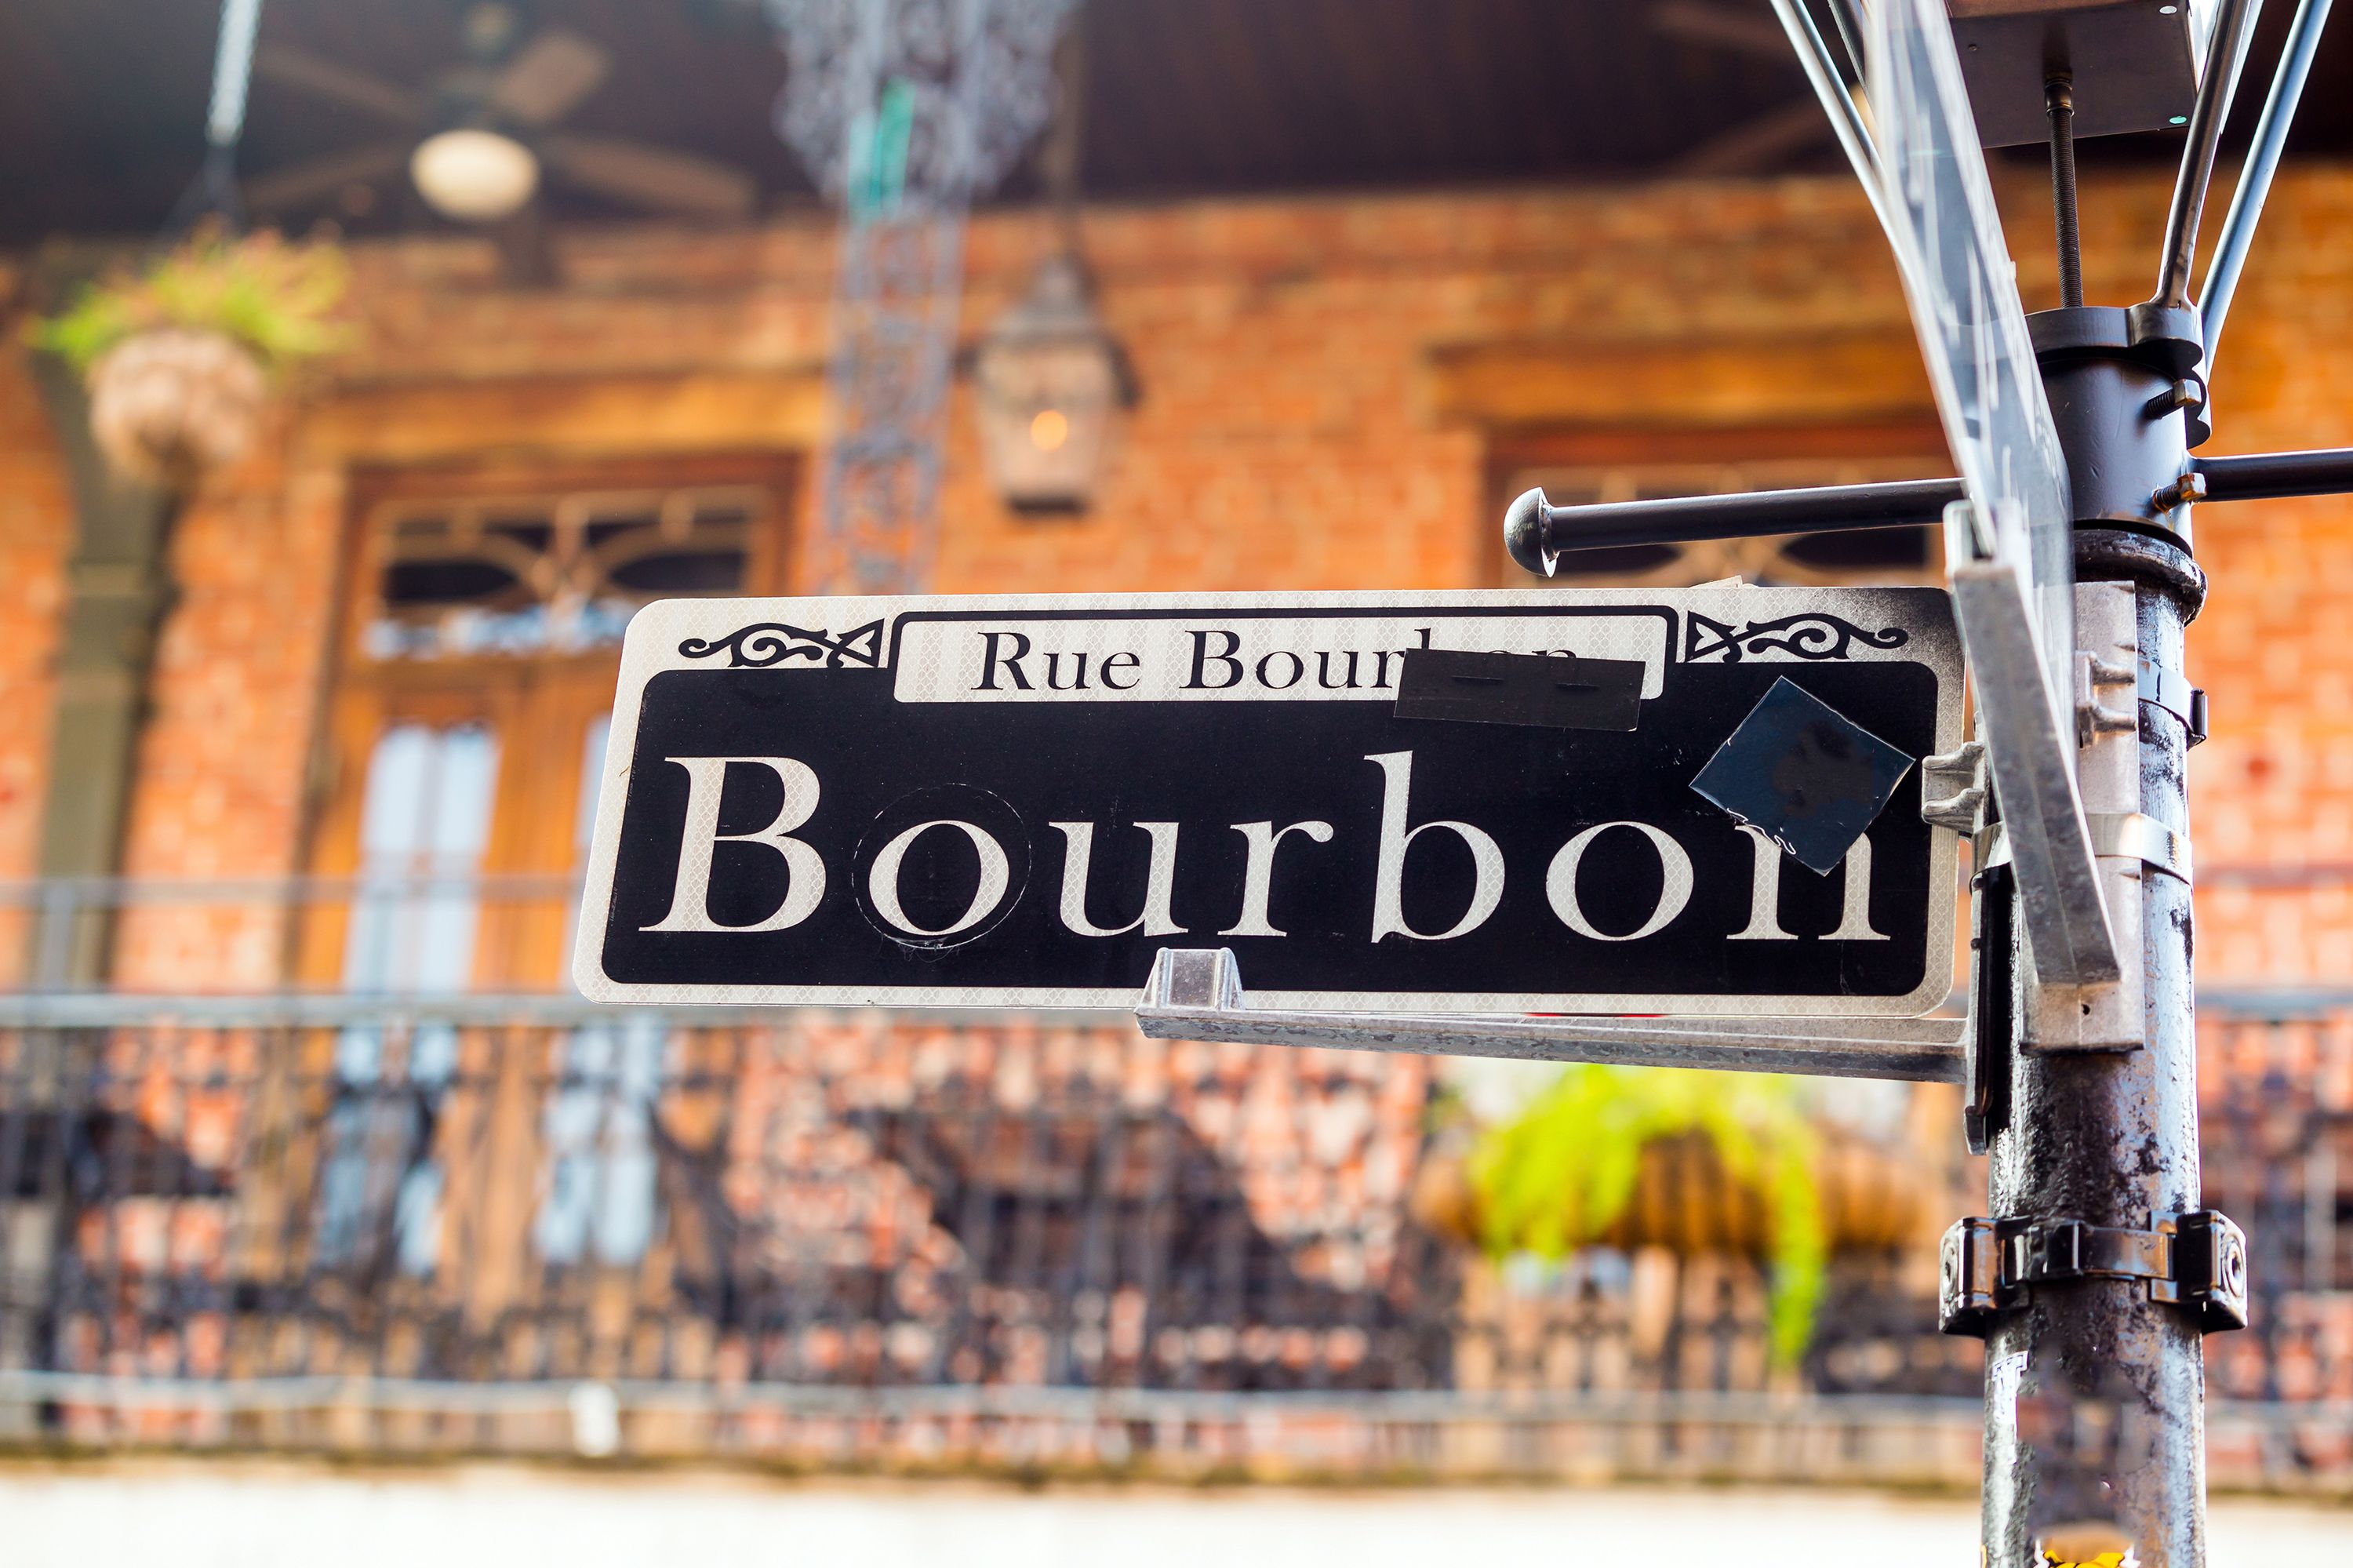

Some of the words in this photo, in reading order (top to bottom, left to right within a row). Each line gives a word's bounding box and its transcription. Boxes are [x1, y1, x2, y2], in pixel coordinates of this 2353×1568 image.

[970, 631, 1140, 691] Rue
[1178, 628, 1577, 689] Bour
[638, 751, 1892, 944] Bourbon
